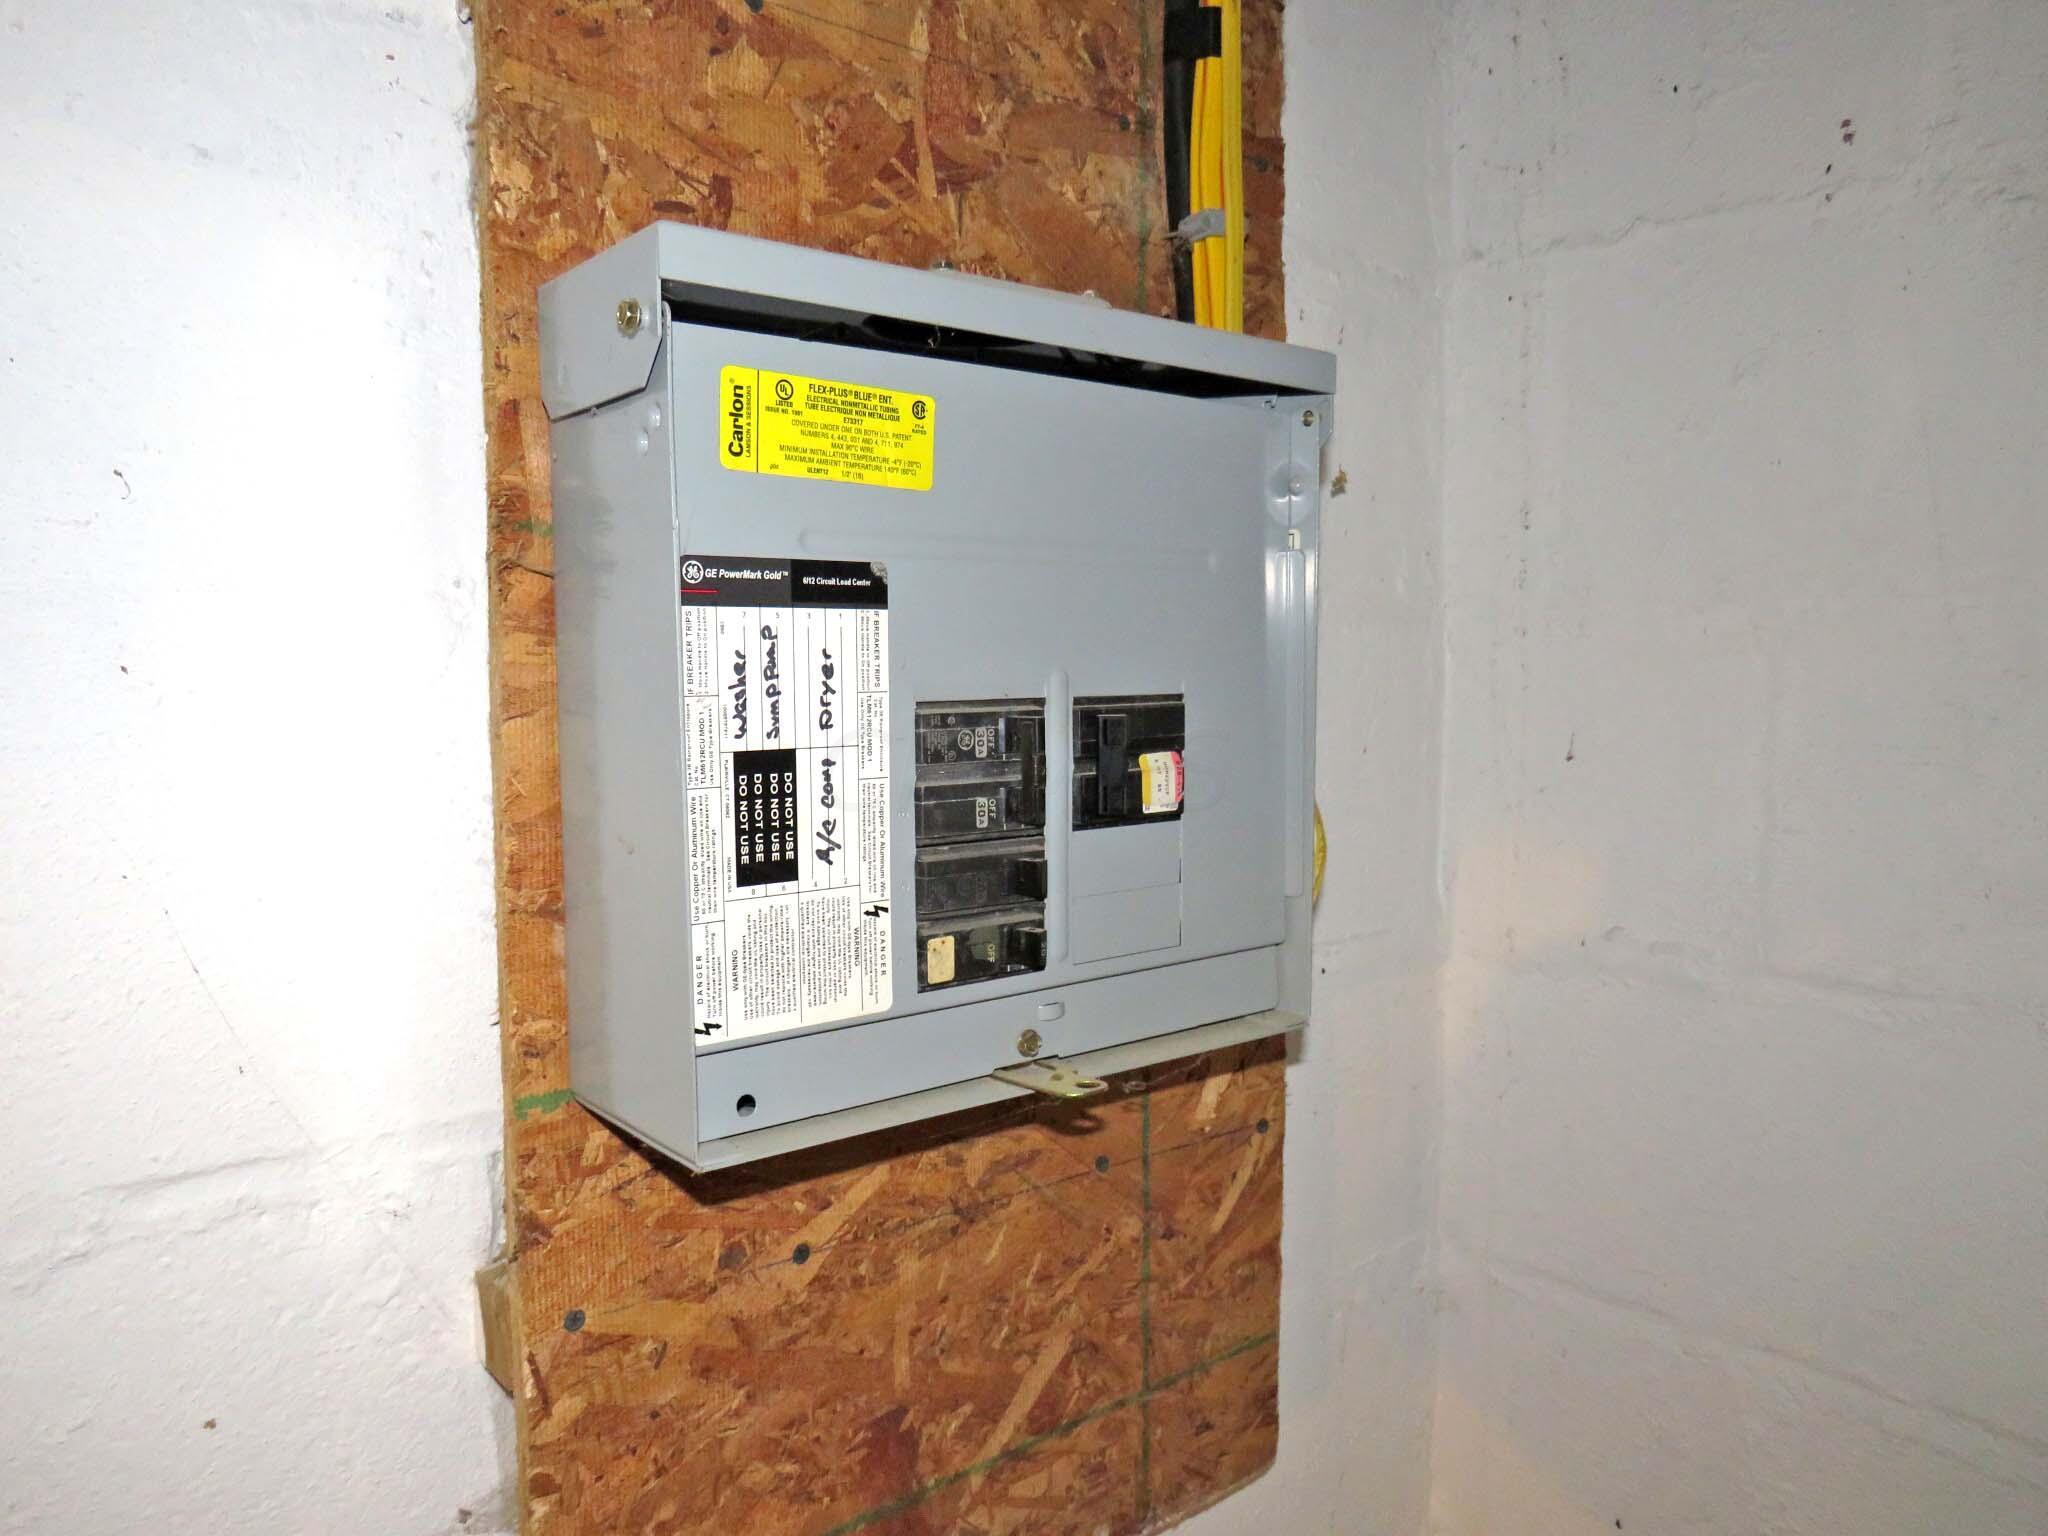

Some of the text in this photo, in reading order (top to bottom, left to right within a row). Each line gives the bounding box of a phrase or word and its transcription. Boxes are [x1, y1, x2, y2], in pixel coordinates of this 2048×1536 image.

[775, 400, 793, 408] LISTED
[805, 402, 900, 422] TUBE ELECTRIQUE NON METALLIQUE
[806, 395, 899, 414] ELECTRICAL NONMETALLIC TUBING
[728, 384, 744, 457] Carlon
[792, 419, 819, 430] COVERED
[820, 422, 840, 432] UNDER
[841, 425, 853, 434] ONE
[854, 427, 862, 435] ON
[863, 428, 879, 437] BOTH
[892, 432, 912, 441] PATENT
[800, 429, 829, 440] NUMBERS
[779, 444, 808, 454] MINIMUM
[809, 447, 849, 460] INSTALLATION
[850, 453, 890, 465] TEMPERATURE
[831, 442, 844, 450] MAX
[859, 445, 874, 454] WIRE
[784, 454, 815, 464] MAXIMUM
[816, 457, 841, 467] AMBIENT
[843, 460, 883, 473] TEMPERATURE
[704, 569, 718, 578] GE
[719, 569, 762, 580] PowerMark
[816, 577, 836, 586] Circuit
[837, 578, 852, 586] Load
[853, 579, 871, 587] Center
[685, 610, 694, 637] TRIPS
[873, 610, 880, 618] IF
[686, 641, 694, 685] BREAKER
[687, 687, 695, 695] IF
[819, 648, 836, 730] Dryer
[977, 730, 986, 757] 30A
[987, 728, 995, 749] OFF
[690, 796, 698, 816] Wire
[784, 772, 795, 860] DO NOT USE
[878, 799, 886, 827] Copper
[977, 801, 986, 826] 30A
[988, 799, 997, 819] OFF
[739, 774, 750, 865] DO NOT USE
[754, 773, 765, 863] DO NOT USE
[770, 773, 780, 861] DO NOT USE
[690, 817, 699, 858] Aluminum
[691, 861, 699, 871] Or
[692, 873, 701, 904] Copper
[987, 943, 996, 963] OFF
[696, 955, 704, 1005] DANGER
[731, 950, 739, 992] WARNING
